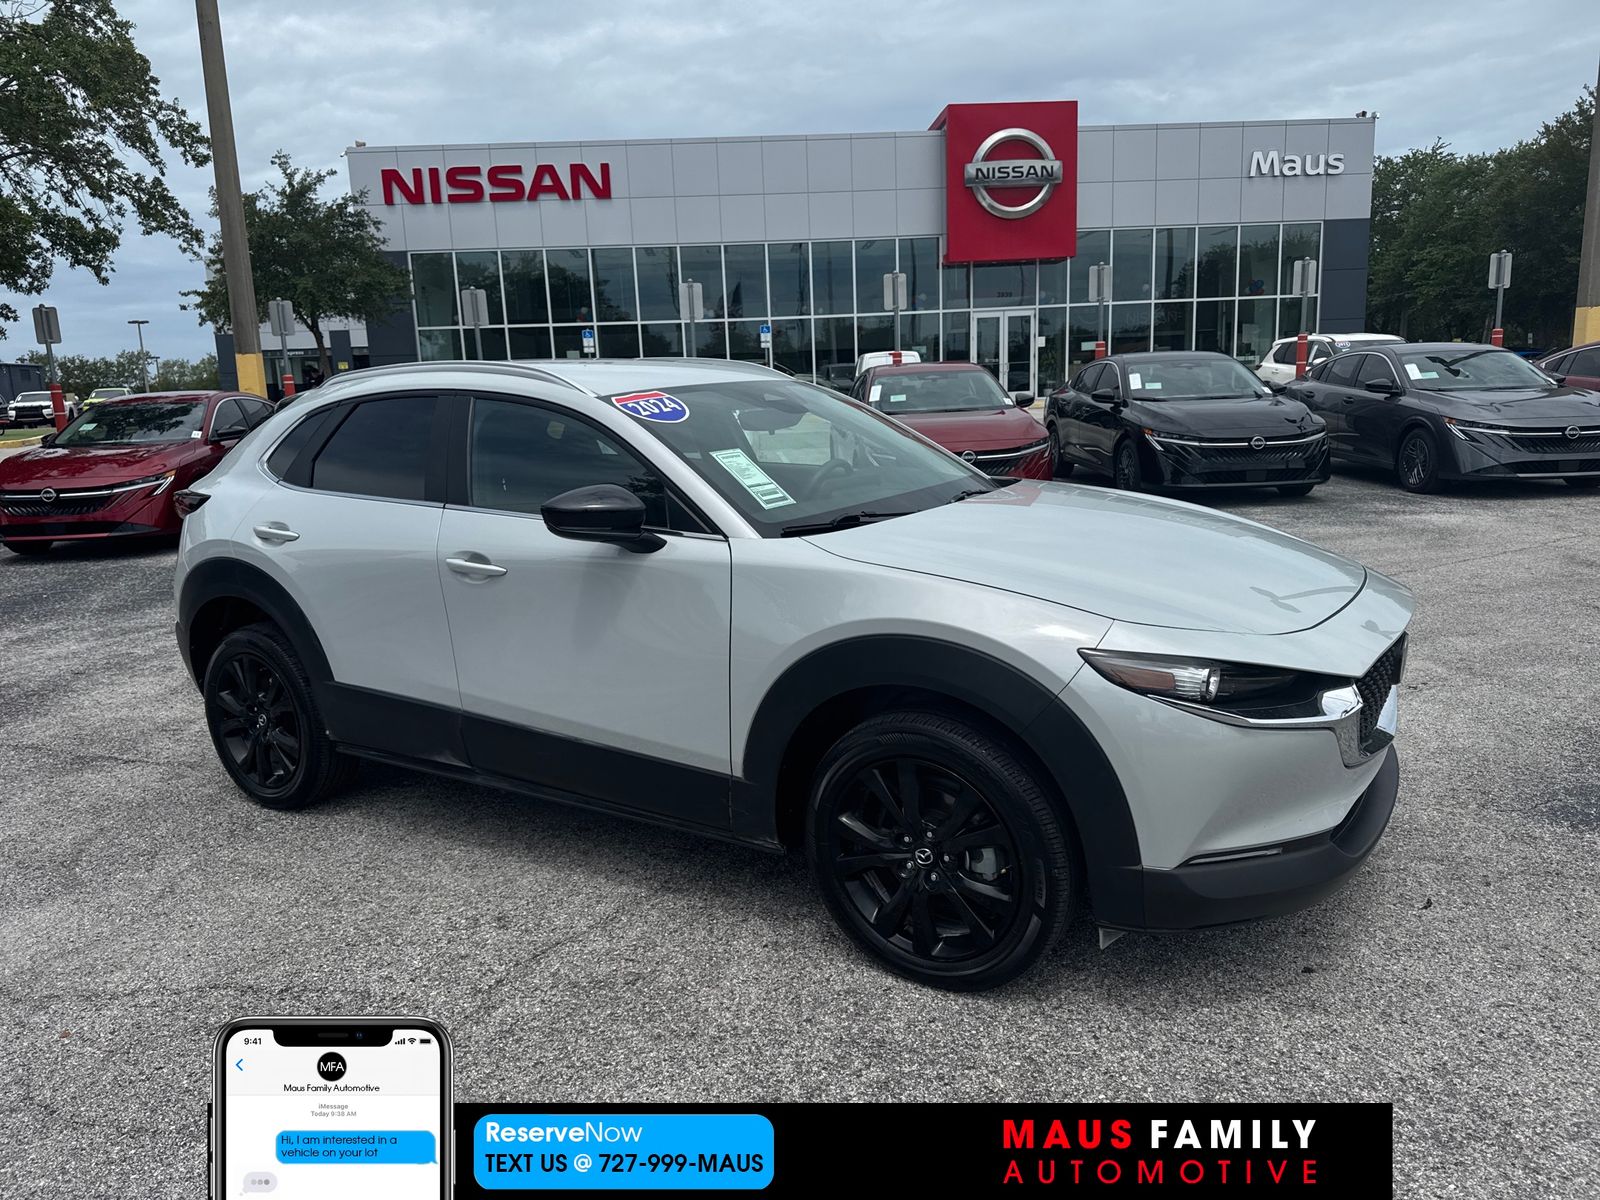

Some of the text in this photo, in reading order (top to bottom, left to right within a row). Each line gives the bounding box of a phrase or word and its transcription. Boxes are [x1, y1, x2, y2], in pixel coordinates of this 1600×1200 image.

[975, 165, 1054, 180] NISSAN
[1249, 150, 1345, 177] Maus
[381, 162, 611, 205] NISSAN
[627, 397, 682, 416] 2024
